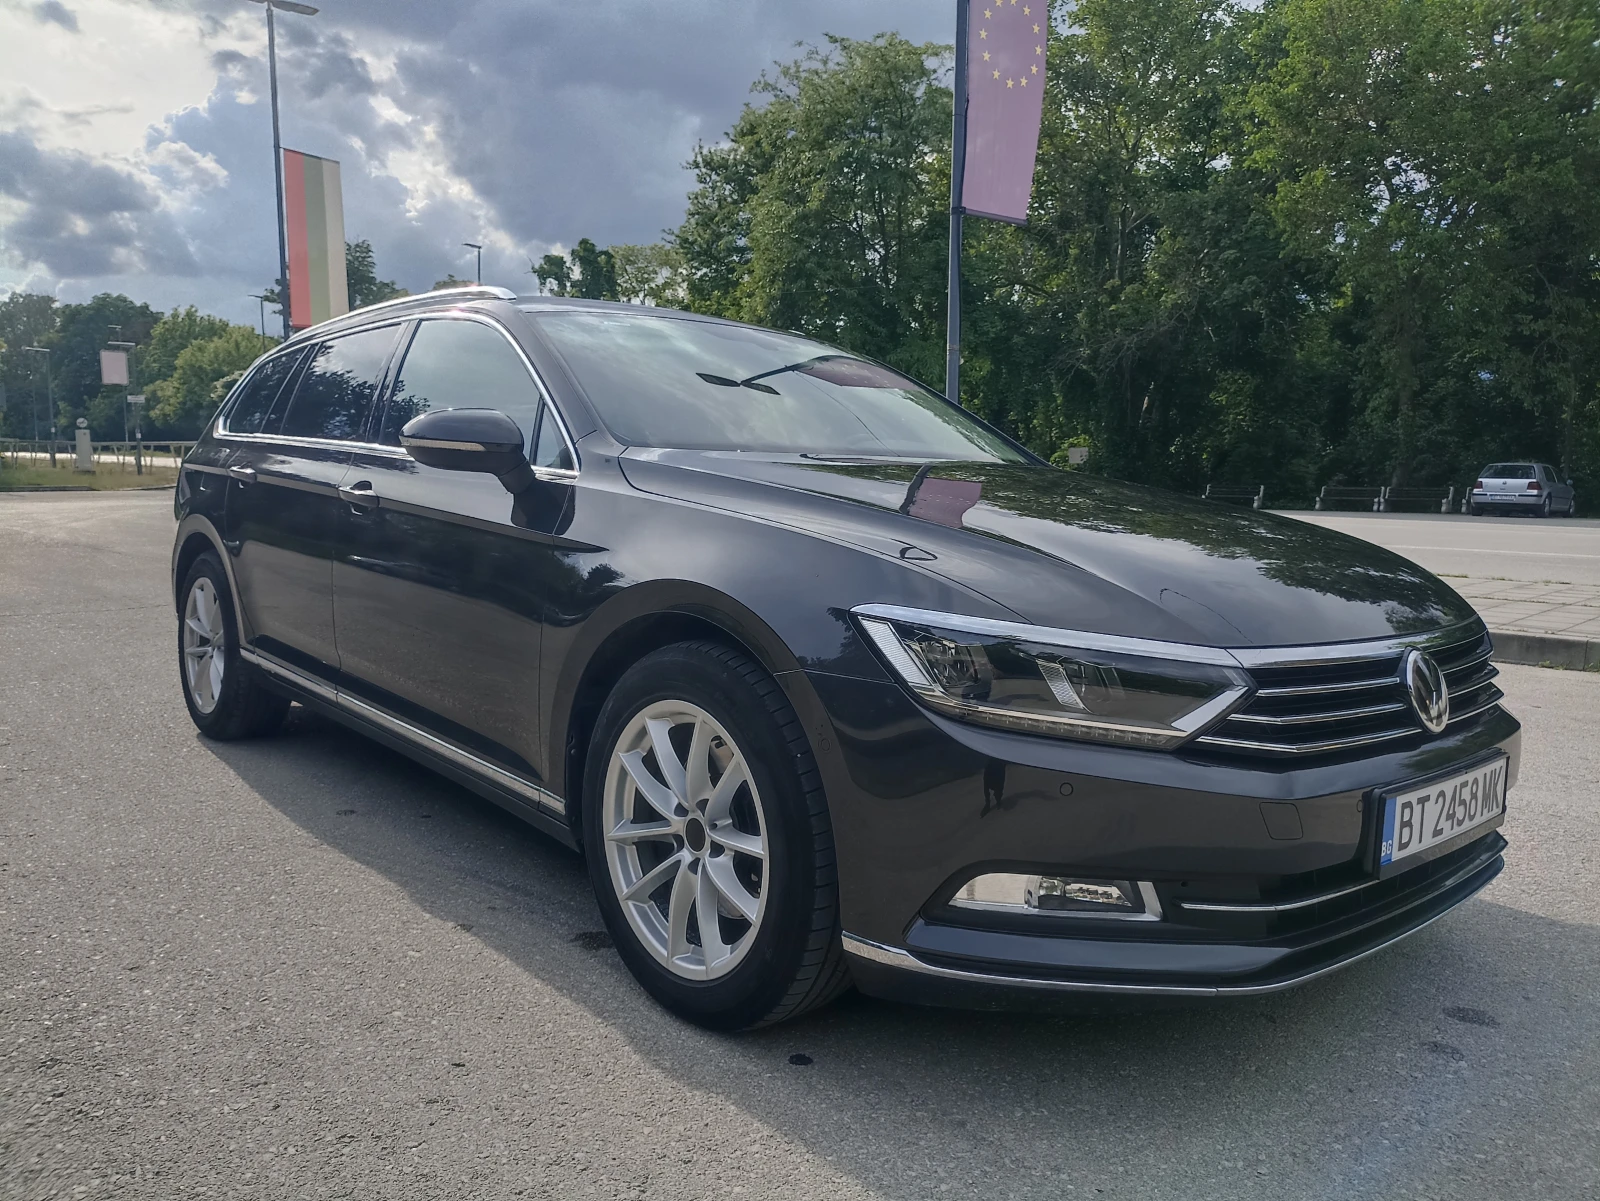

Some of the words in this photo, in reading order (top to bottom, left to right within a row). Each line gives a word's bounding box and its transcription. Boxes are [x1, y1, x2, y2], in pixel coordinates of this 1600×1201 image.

[1397, 794, 1431, 852] BT
[1432, 777, 1479, 838] 2458
[1480, 765, 1503, 816] MK
[1381, 841, 1393, 856] BG
